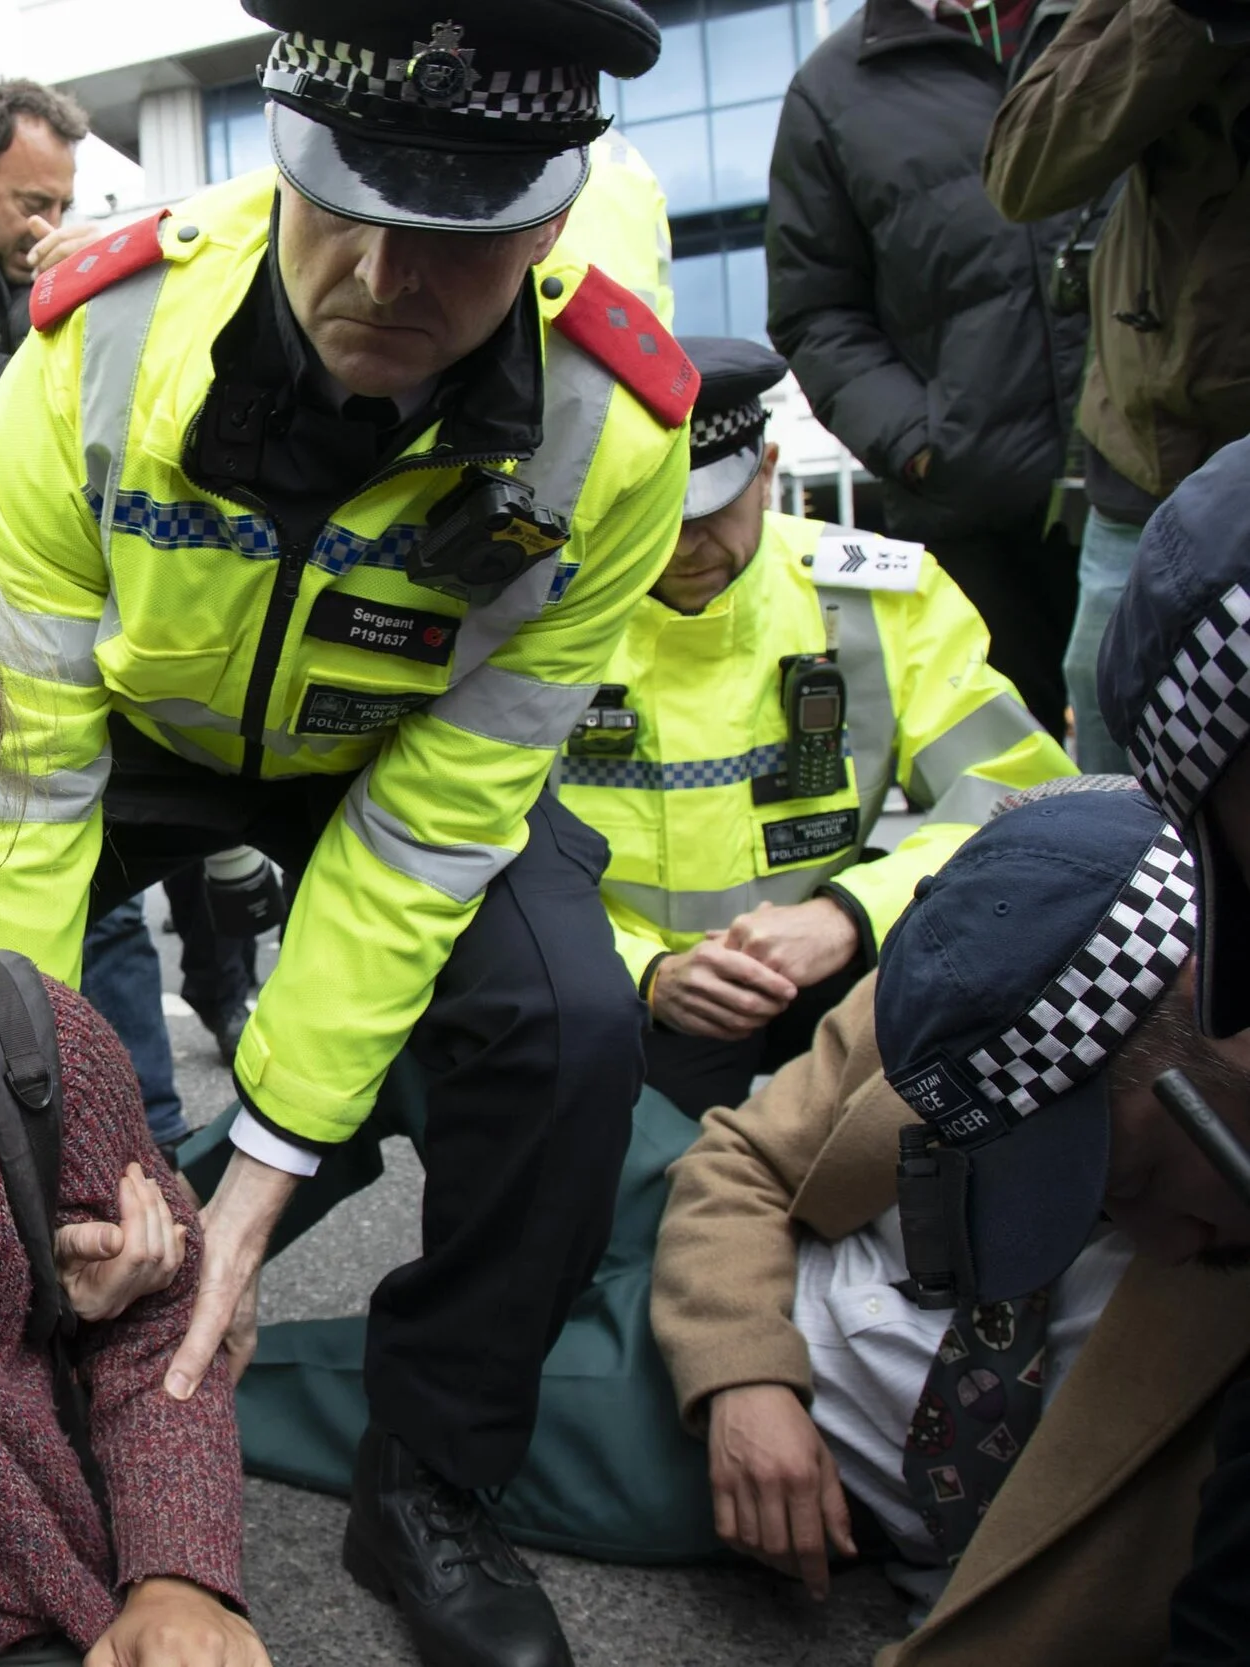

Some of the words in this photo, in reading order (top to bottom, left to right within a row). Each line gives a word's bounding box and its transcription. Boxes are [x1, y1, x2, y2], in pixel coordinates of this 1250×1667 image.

[353, 607, 415, 630] Sergeant
[349, 626, 408, 647] P191637
[306, 717, 358, 732] POLICE
[770, 846, 809, 861] POLICE
